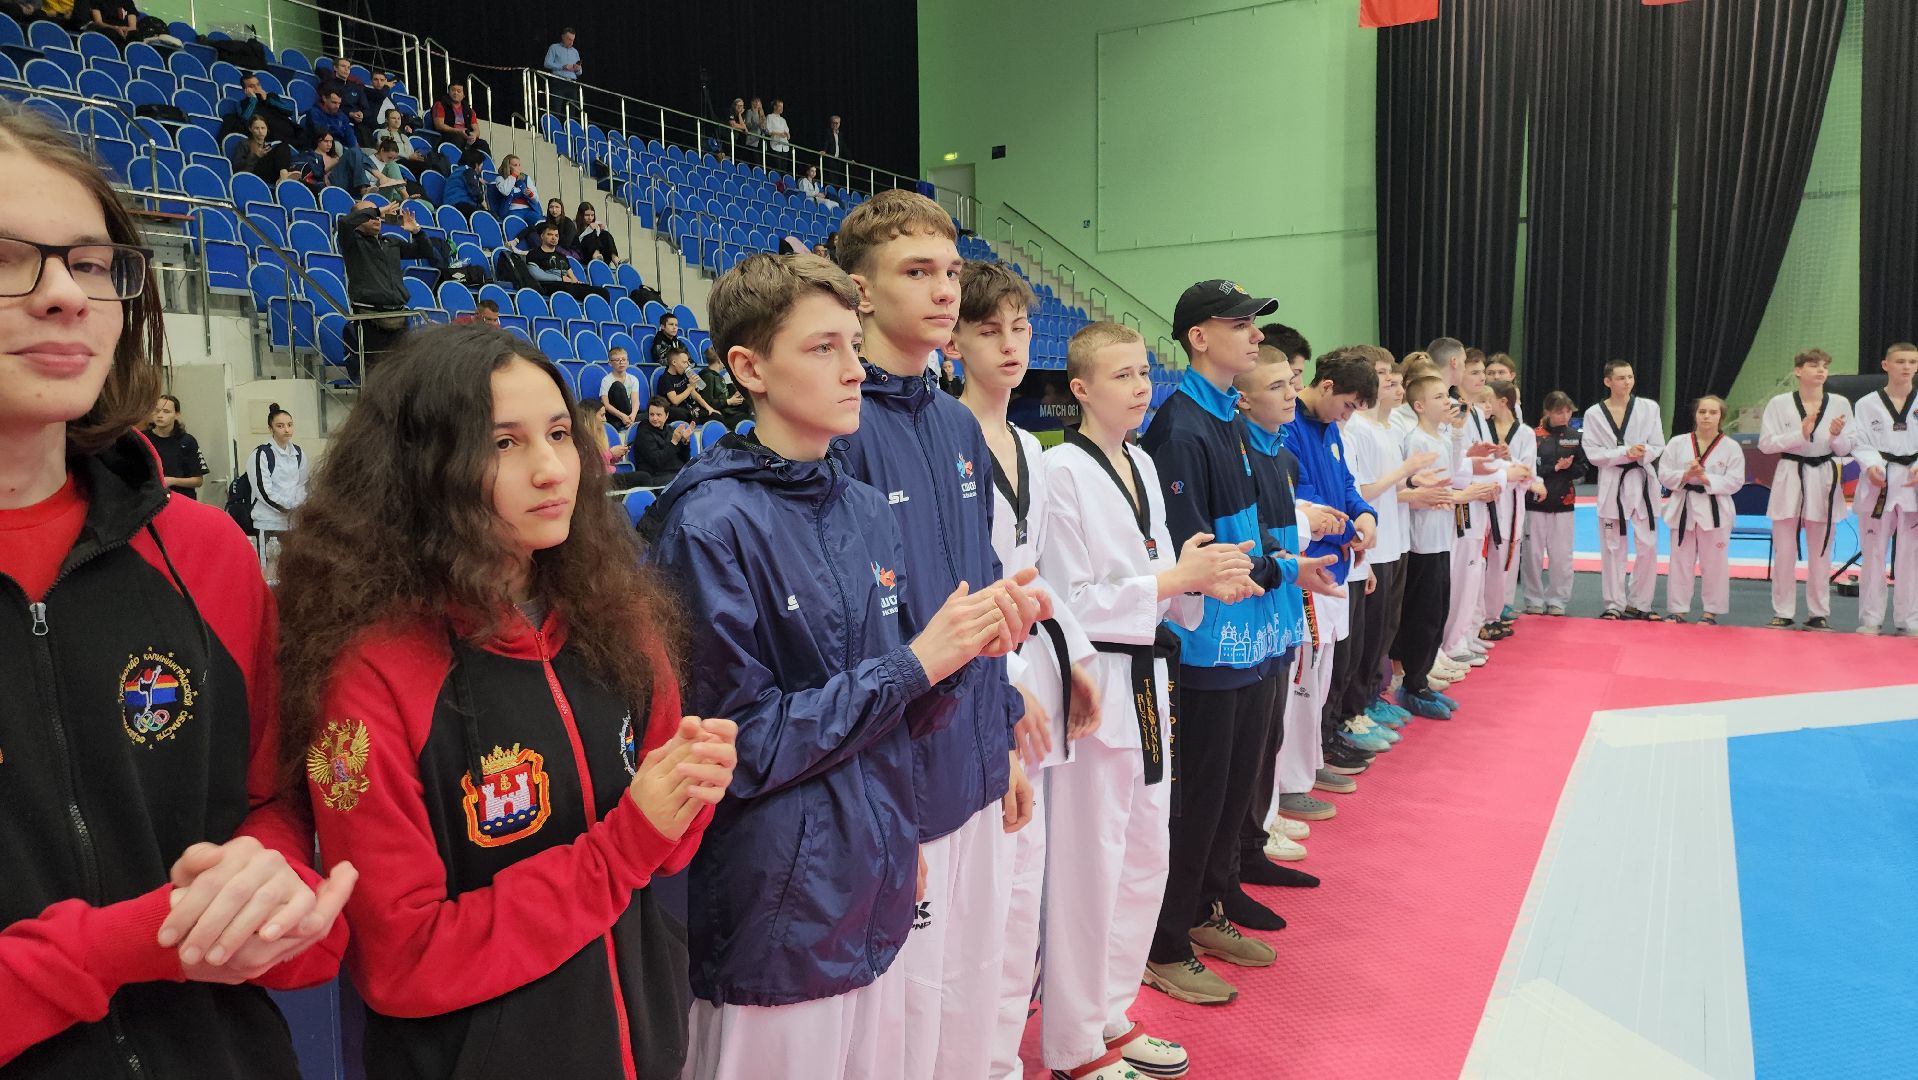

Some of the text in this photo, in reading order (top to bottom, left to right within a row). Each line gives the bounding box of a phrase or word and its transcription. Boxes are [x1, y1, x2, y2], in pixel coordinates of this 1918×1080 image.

[1039, 404, 1079, 418] MATCH 061
[1303, 604, 1319, 647] RUSSIA
[143, 652, 194, 706] КАЛИНИНГРАДСКОЙ
[1136, 692, 1151, 751] RUSSIA
[1143, 678, 1160, 763] TAEKWONDO
